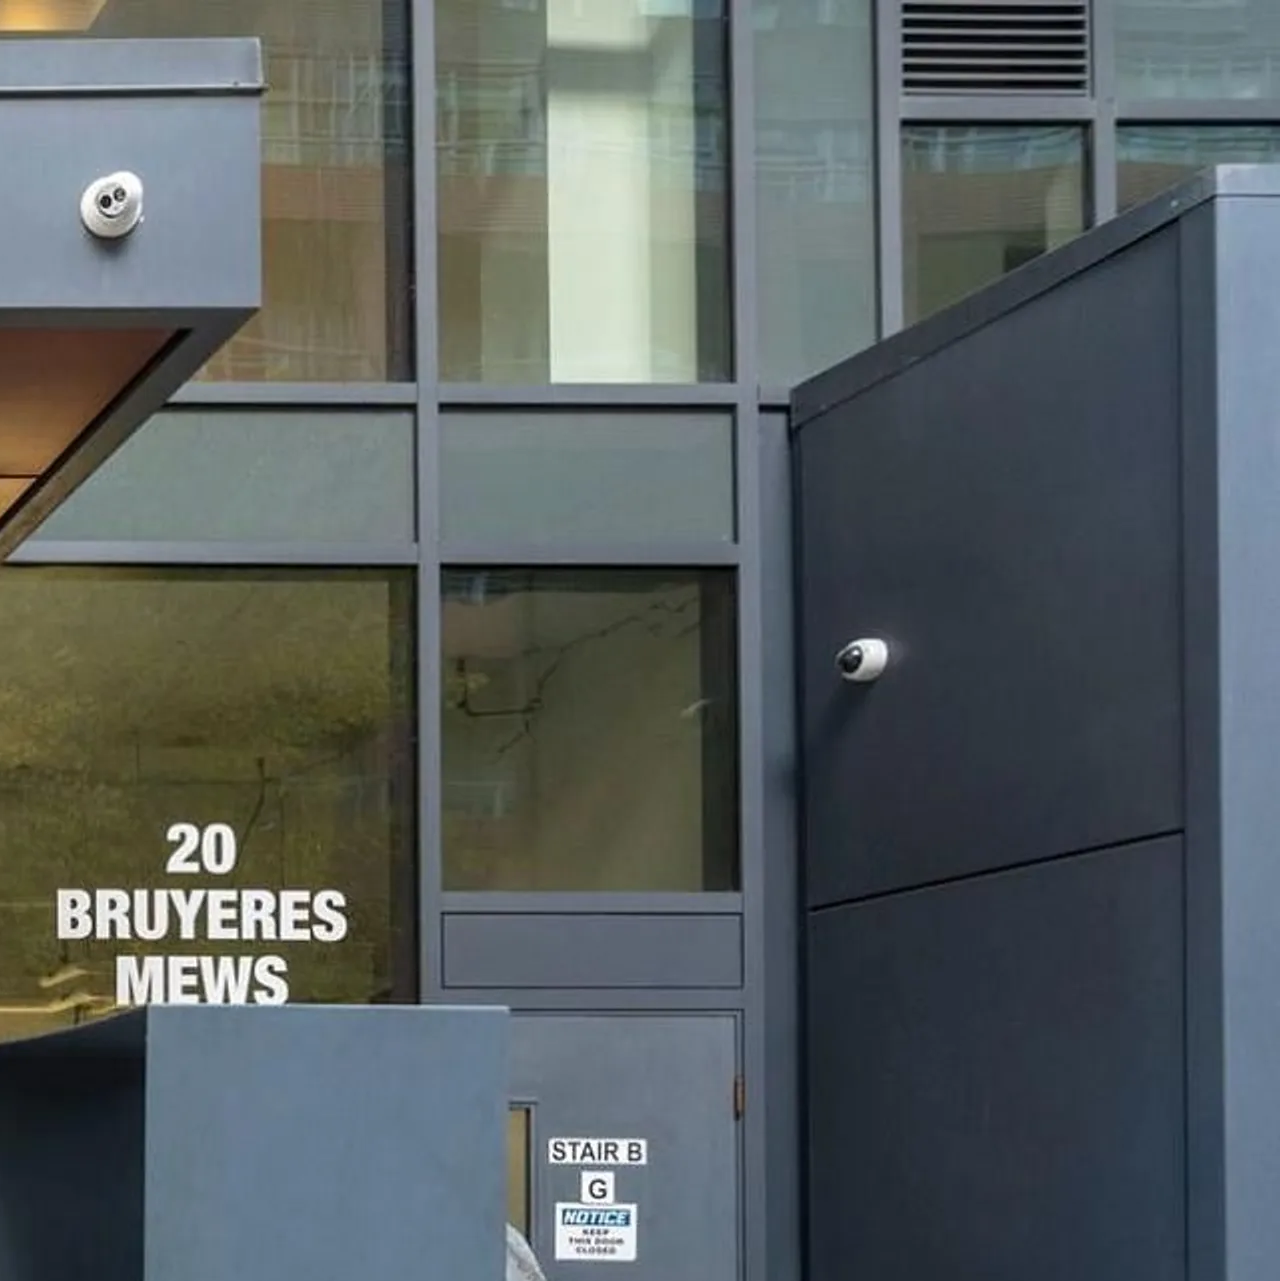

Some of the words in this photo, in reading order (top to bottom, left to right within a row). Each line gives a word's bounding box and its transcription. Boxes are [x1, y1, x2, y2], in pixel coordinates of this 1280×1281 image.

[165, 822, 237, 875] 20
[56, 888, 348, 942] BRUYERES
[115, 955, 289, 1005] MEWS
[551, 1141, 619, 1162] STAIR
[627, 1141, 642, 1162] B
[588, 1178, 608, 1200] G
[563, 1209, 629, 1225] NOTICE
